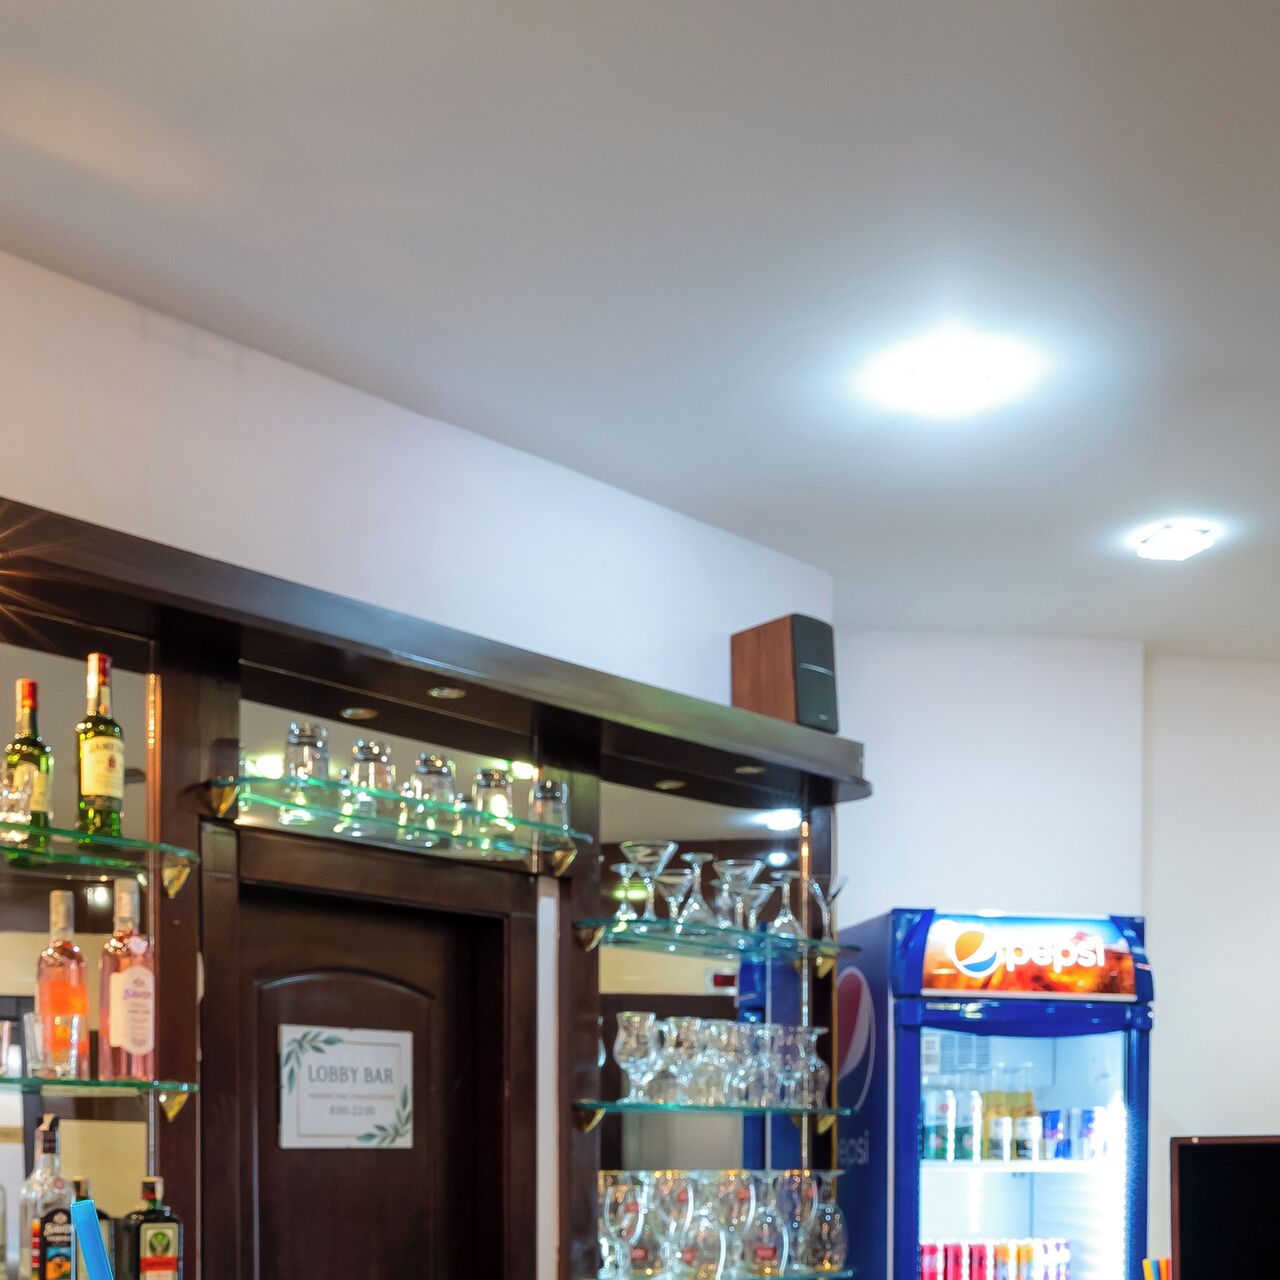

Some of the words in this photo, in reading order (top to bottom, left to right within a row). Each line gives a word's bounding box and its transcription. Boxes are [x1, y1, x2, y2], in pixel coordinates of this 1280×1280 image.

[1006, 936, 1106, 973] pepsi
[308, 1065, 359, 1083] LOBBY
[363, 1067, 394, 1084] BAR
